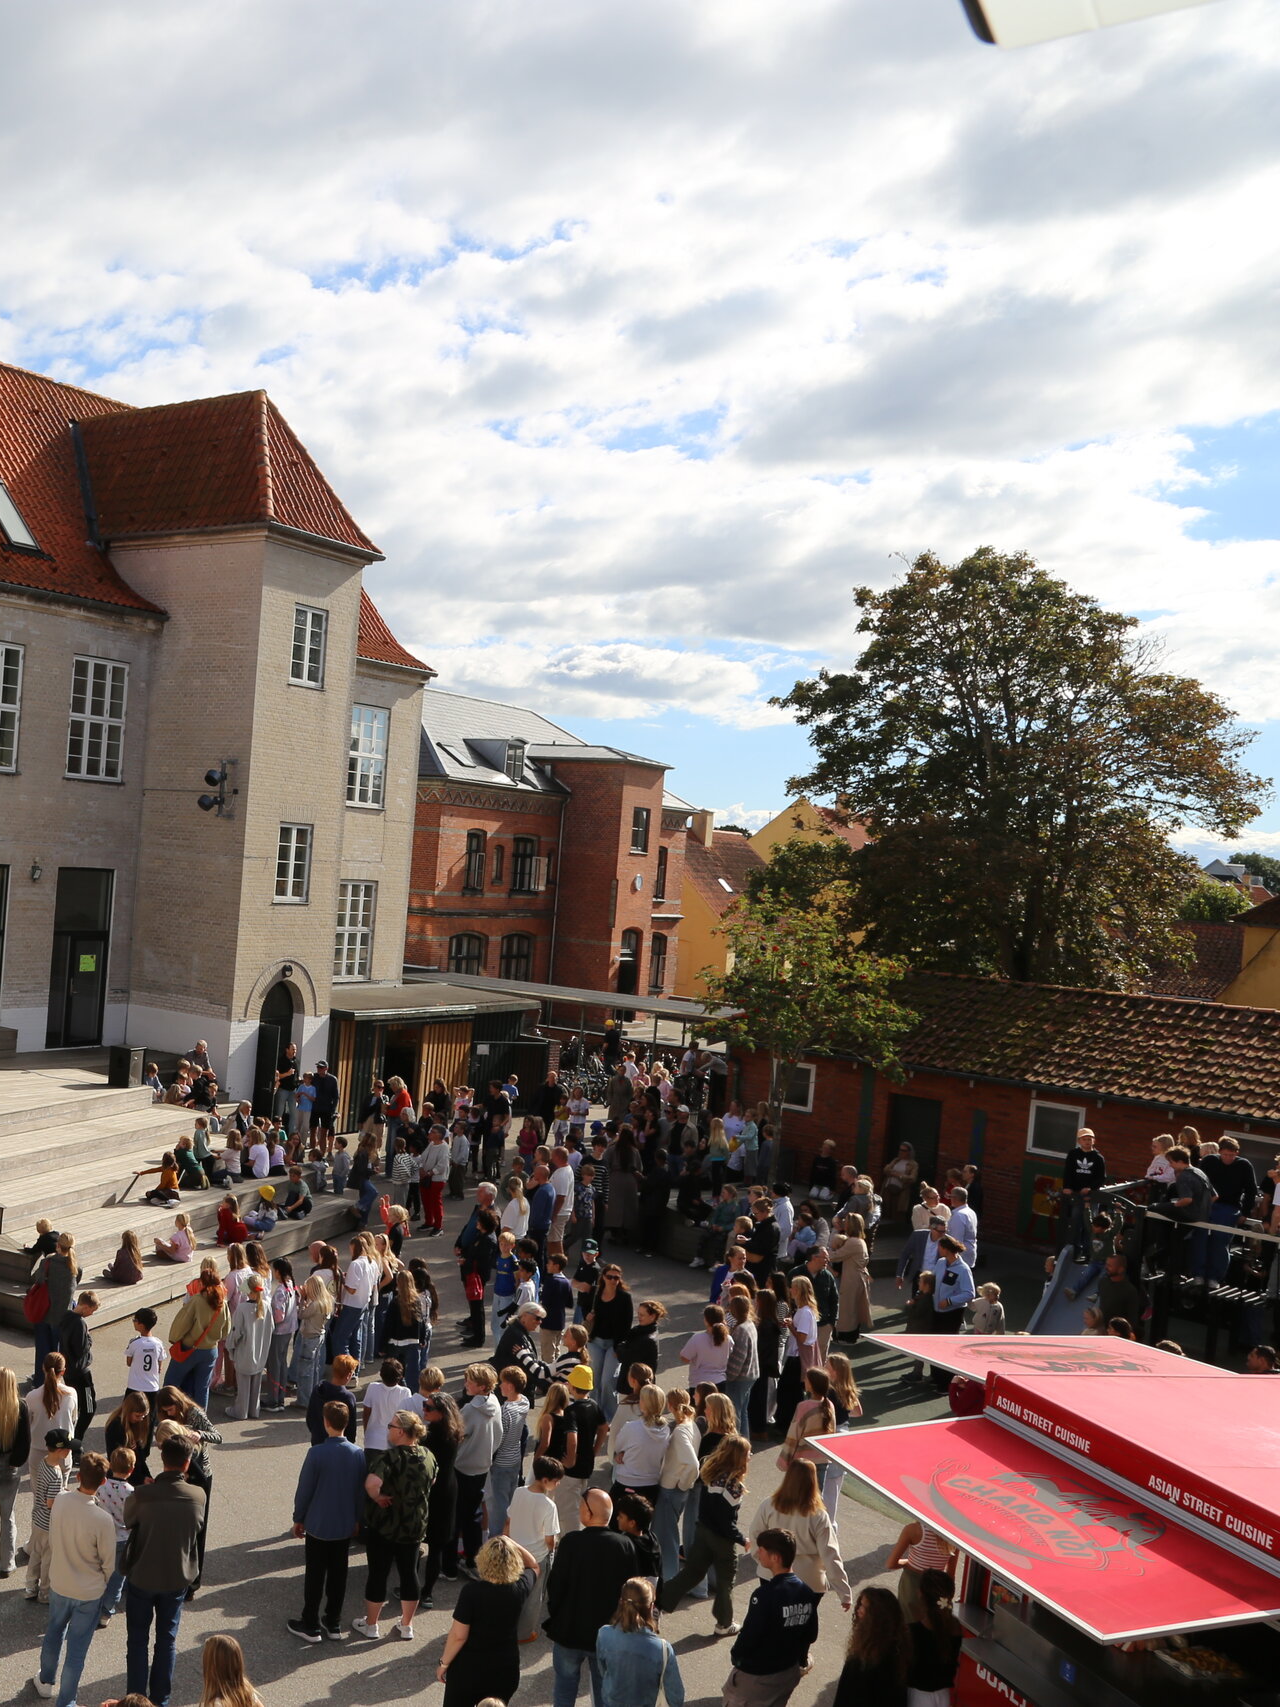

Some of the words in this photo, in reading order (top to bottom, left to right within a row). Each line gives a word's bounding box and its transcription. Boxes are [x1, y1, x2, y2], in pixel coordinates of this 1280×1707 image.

[143, 1354, 152, 1372] 9
[996, 1395, 1022, 1417] ASIAN
[1022, 1408, 1053, 1433] STREET
[1054, 1425, 1091, 1453] CUISINE
[947, 1478, 1056, 1525] CHANG
[1044, 1530, 1094, 1557] NOI
[1148, 1474, 1180, 1502] ASIAN
[1183, 1492, 1223, 1522] STREET
[1225, 1514, 1274, 1551] CUISINE
